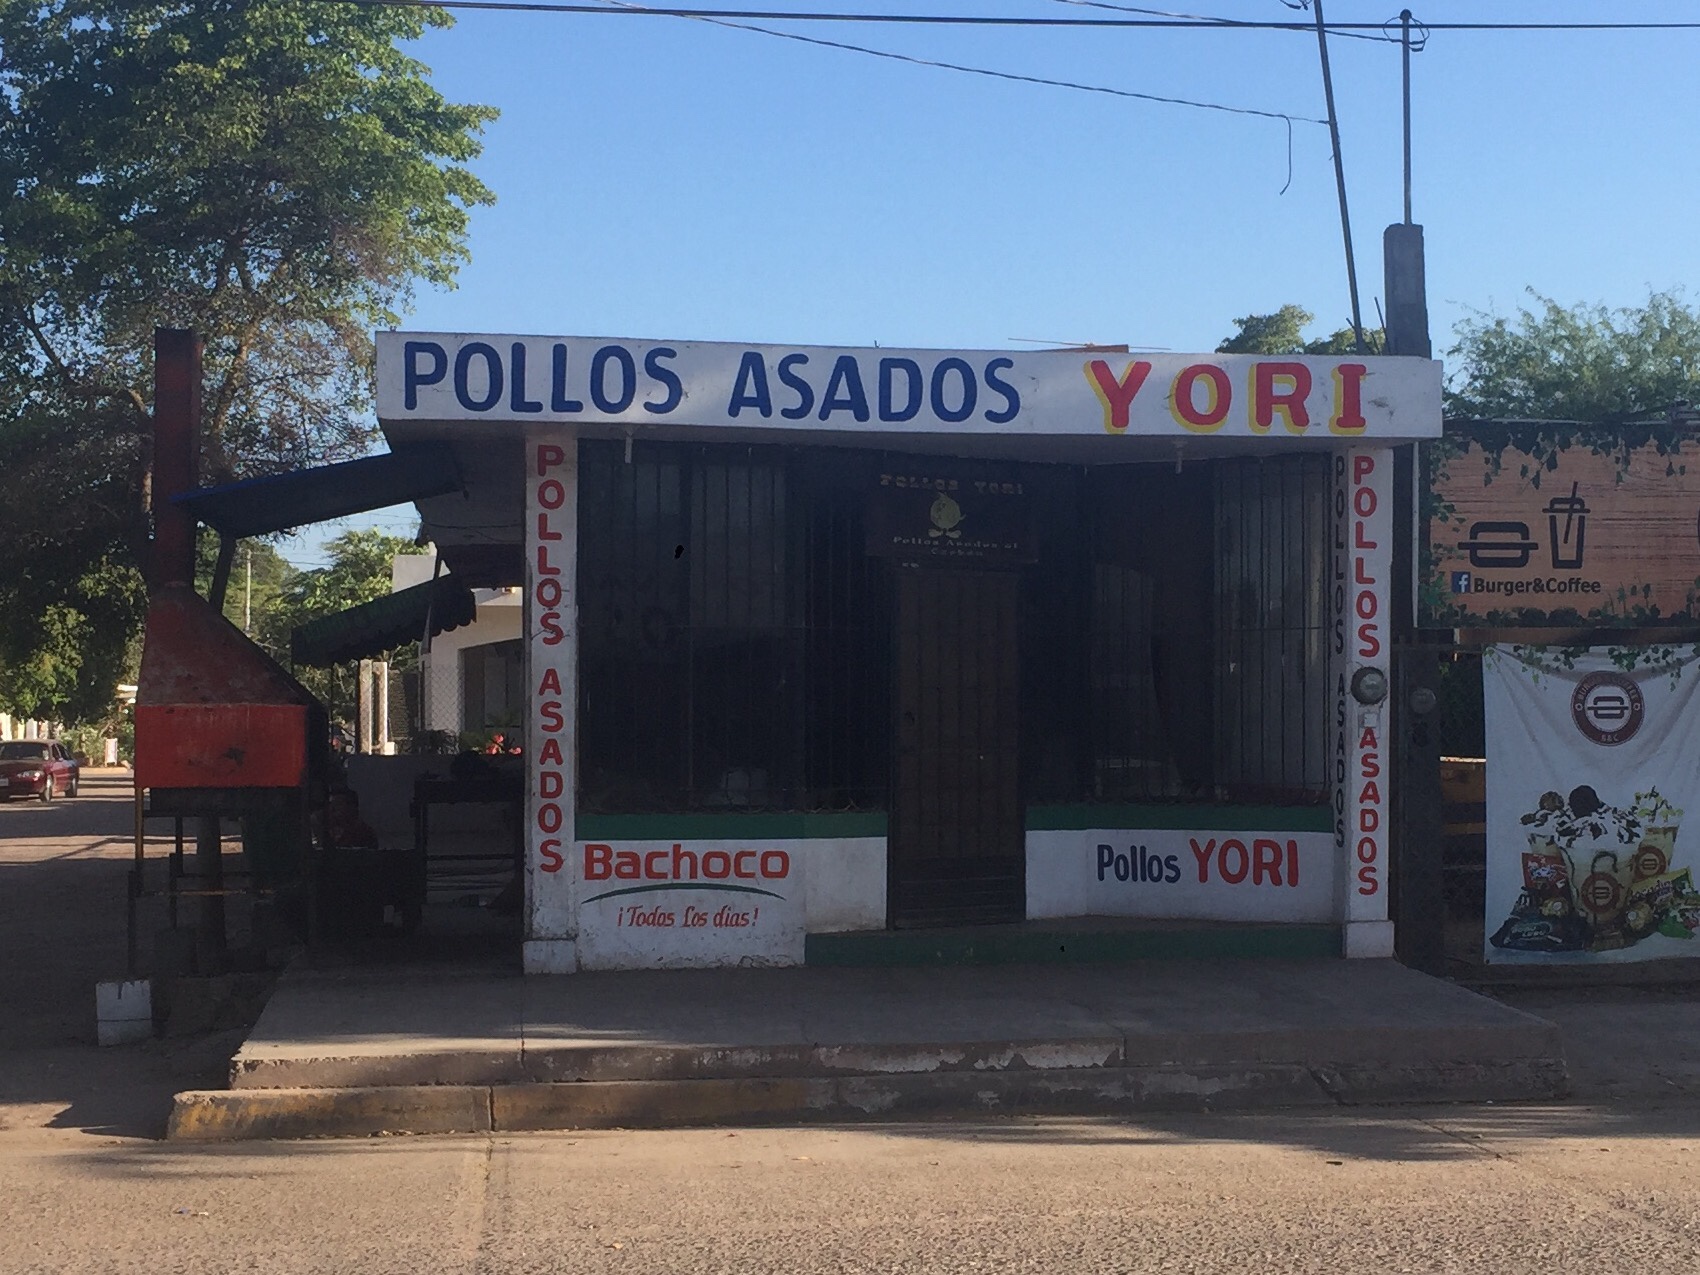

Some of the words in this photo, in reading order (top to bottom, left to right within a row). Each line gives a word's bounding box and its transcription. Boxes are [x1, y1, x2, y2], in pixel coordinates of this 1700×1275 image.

[404, 341, 683, 414] POLLOS
[728, 351, 1021, 424] ASADOS
[1083, 359, 1368, 435] YORI
[536, 444, 565, 646] POLLOS
[1335, 455, 1345, 655] POLLOS
[1354, 455, 1380, 658] POLLOS
[1474, 577, 1601, 596] Burger&Coffee
[538, 668, 564, 873] ASADOS
[1335, 672, 1345, 848] ASADOS
[1357, 727, 1380, 896] ASADOS
[584, 843, 790, 881] Bachoco
[1097, 844, 1181, 884] Pollos
[1189, 838, 1299, 888] YORI
